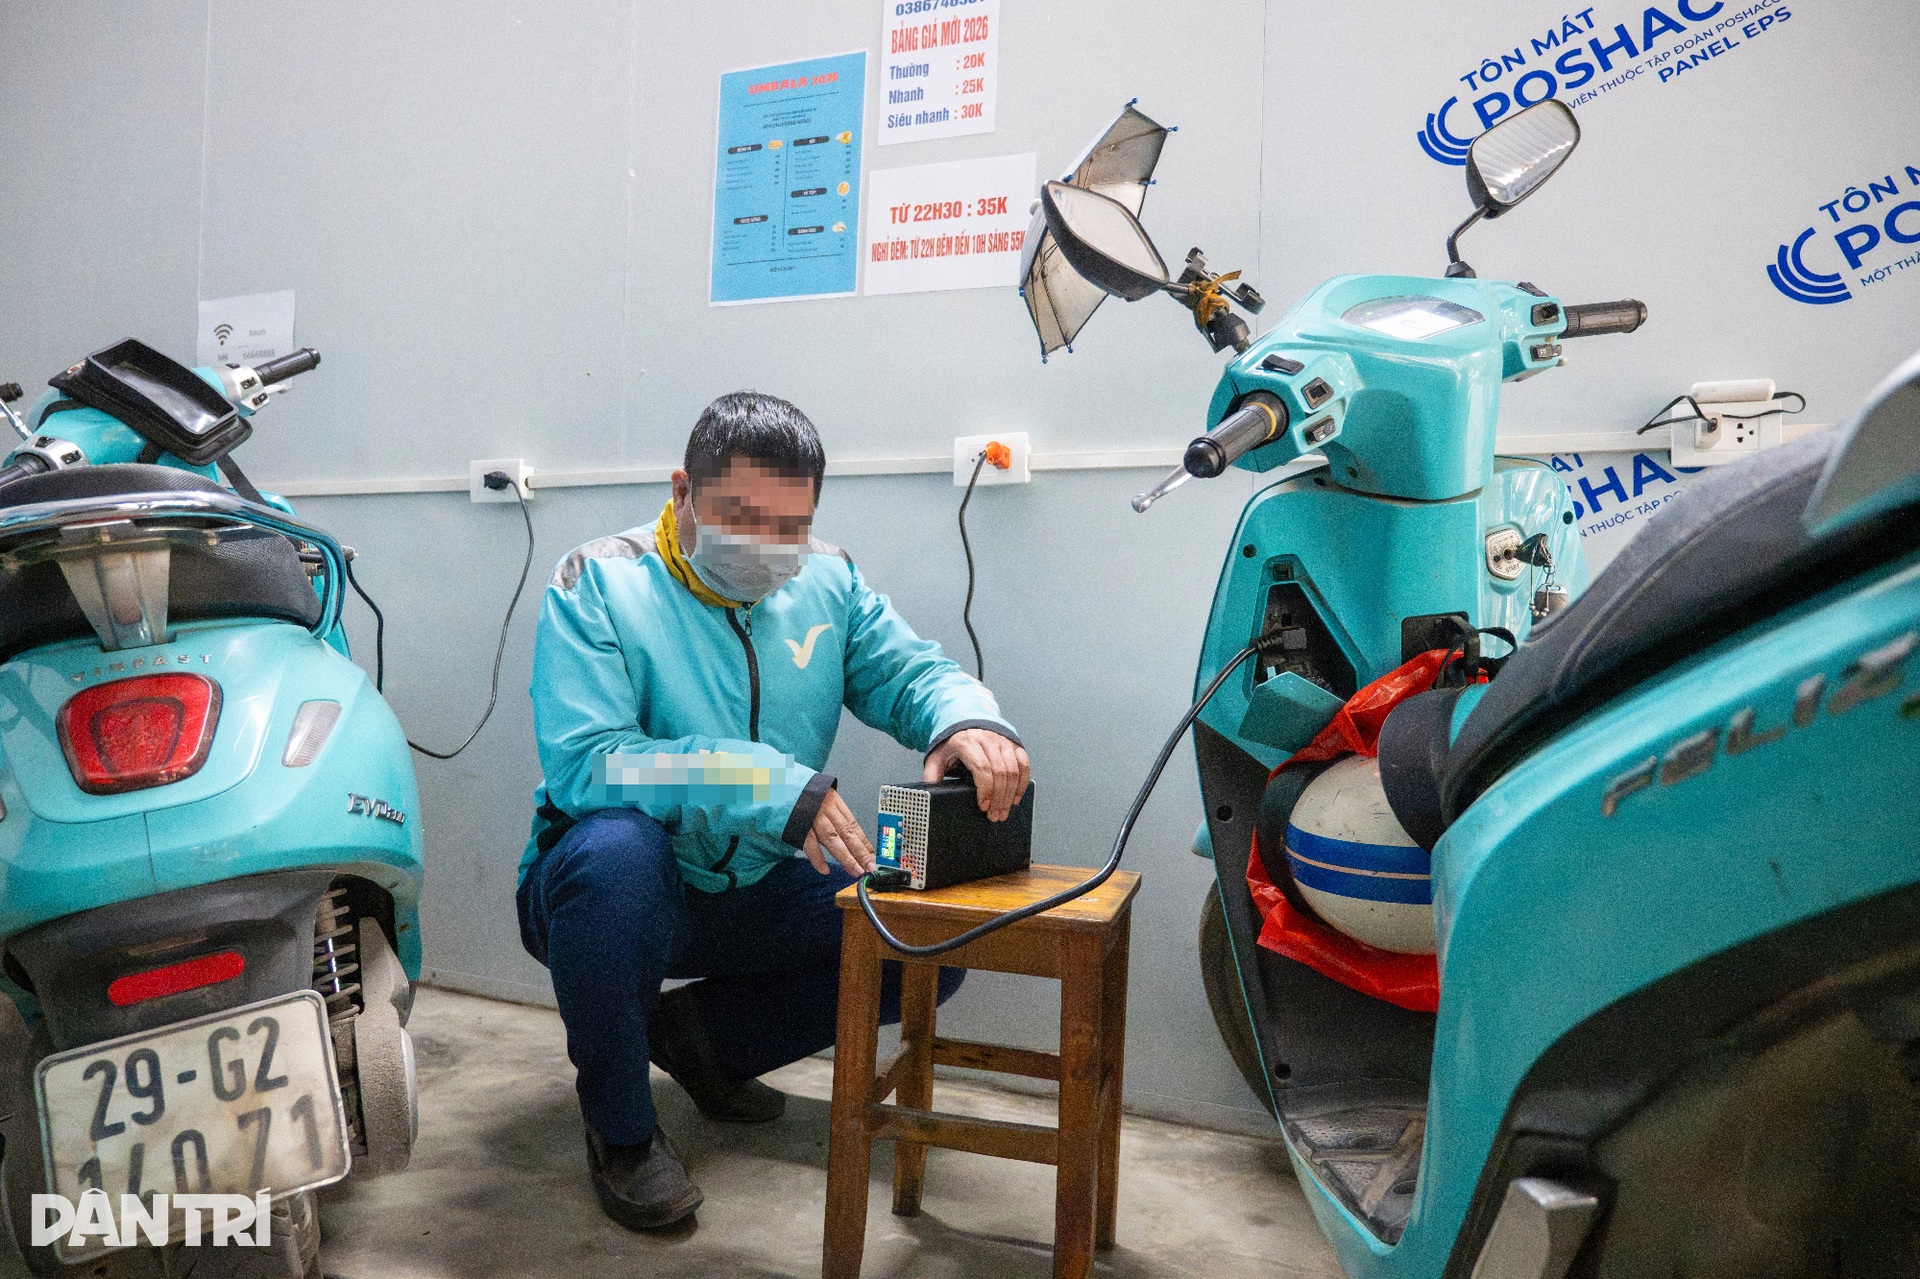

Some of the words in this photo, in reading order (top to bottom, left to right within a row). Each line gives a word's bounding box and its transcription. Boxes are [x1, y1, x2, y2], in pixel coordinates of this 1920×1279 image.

[891, 20, 919, 54] BẢNG
[921, 17, 938, 50] GIÁ
[940, 14, 961, 47] MỚI
[963, 15, 989, 43] 2026
[1460, 47, 1526, 91] TÔN
[1531, 7, 1594, 56] MÁT
[1657, 35, 1740, 83] PANEL
[1742, 6, 1792, 39] EPS
[889, 62, 930, 80] Thường
[963, 52, 985, 69] 20K
[1600, 64, 1646, 93] THUỘC
[1645, 49, 1671, 70] TẬP
[1673, 28, 1714, 55] ĐOÀN
[888, 86, 924, 105] Nhanh
[962, 77, 984, 95] 25K
[887, 112, 912, 129] Siêu
[915, 107, 950, 126] nhanh
[961, 102, 983, 119] 30K
[890, 202, 910, 224] TỪ
[913, 201, 963, 222] 22H30
[977, 196, 1008, 217] 35K
[1818, 175, 1900, 223] TÔN
[871, 235, 889, 262] NGHỈ
[910, 235, 920, 259] TỪ
[920, 238, 935, 258] 22H
[972, 233, 986, 254] 10H
[987, 228, 1009, 253] SÁNG
[1860, 265, 1892, 287] MỘT
[1588, 509, 1635, 535] THUỘC
[82, 1015, 289, 1141] 29-G2
